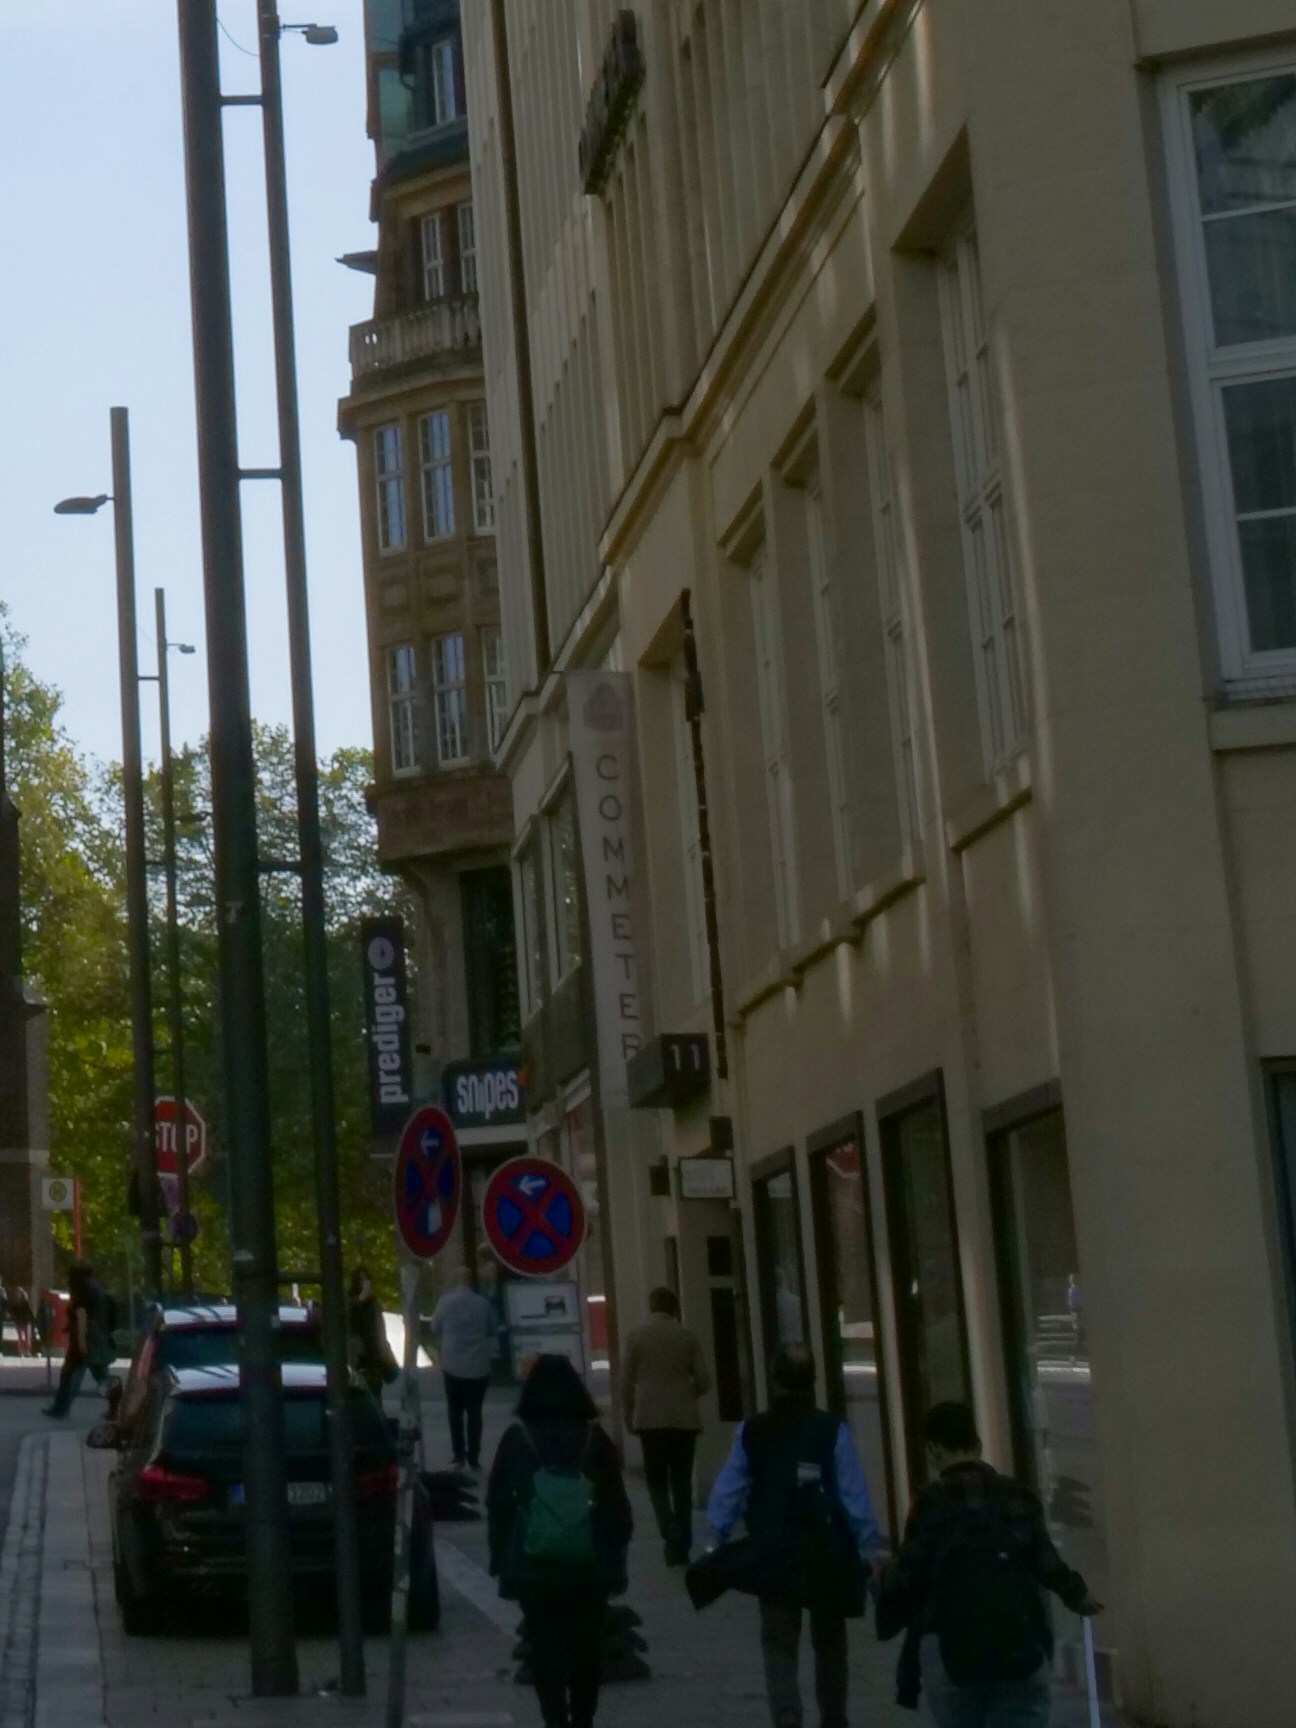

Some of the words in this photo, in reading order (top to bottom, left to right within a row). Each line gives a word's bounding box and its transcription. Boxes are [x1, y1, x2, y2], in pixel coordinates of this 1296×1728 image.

[372, 972, 409, 1105] prediger
[671, 1044, 701, 1072] 11
[458, 1070, 519, 1120] snipes
